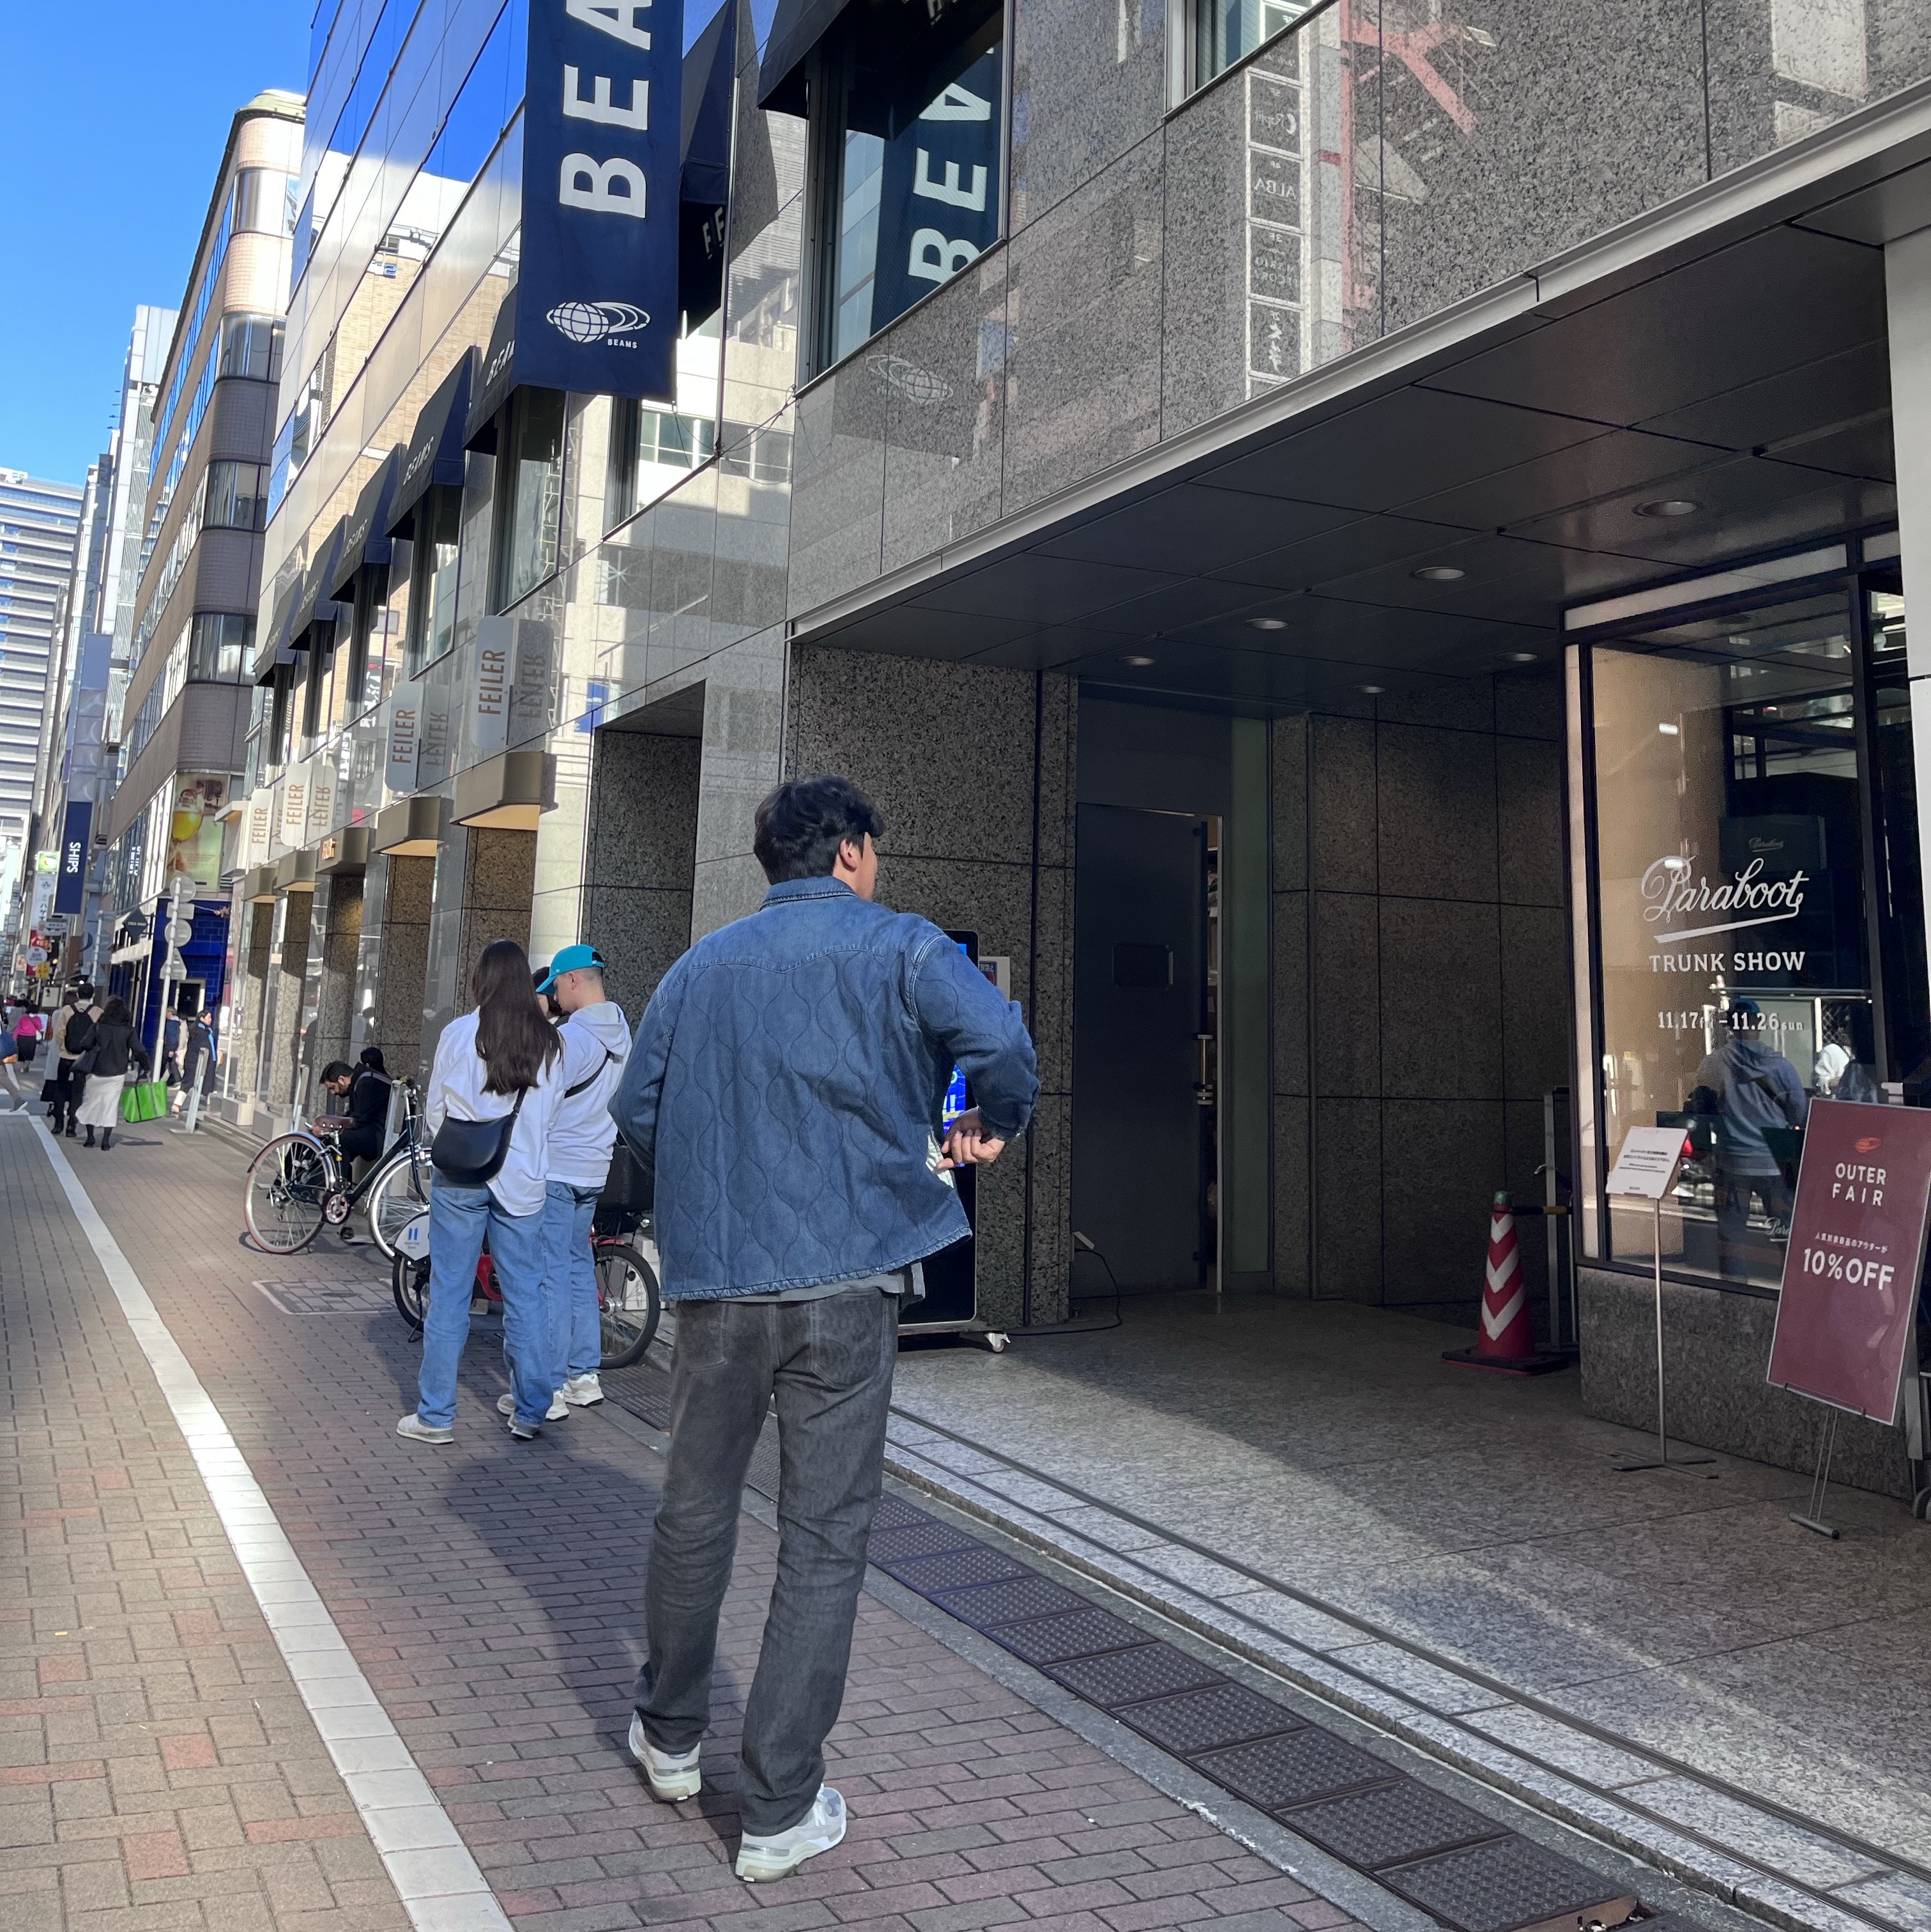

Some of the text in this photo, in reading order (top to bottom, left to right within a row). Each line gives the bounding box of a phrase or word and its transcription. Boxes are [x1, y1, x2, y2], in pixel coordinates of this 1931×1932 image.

[607, 338, 637, 349] BEAMS
[478, 649, 506, 715] FEILER
[392, 709, 416, 764] FEILER
[286, 784, 305, 825] FEILER
[251, 808, 268, 845] FEILER
[66, 841, 81, 874] SHIPS
[1641, 855, 1810, 924] Paraboot
[1649, 951, 1806, 972] TRUNK SHOW
[1835, 1162, 1887, 1185] OUTER
[1832, 1183, 1884, 1206] FAIR
[1803, 1248, 1895, 1290] 10%OFF
